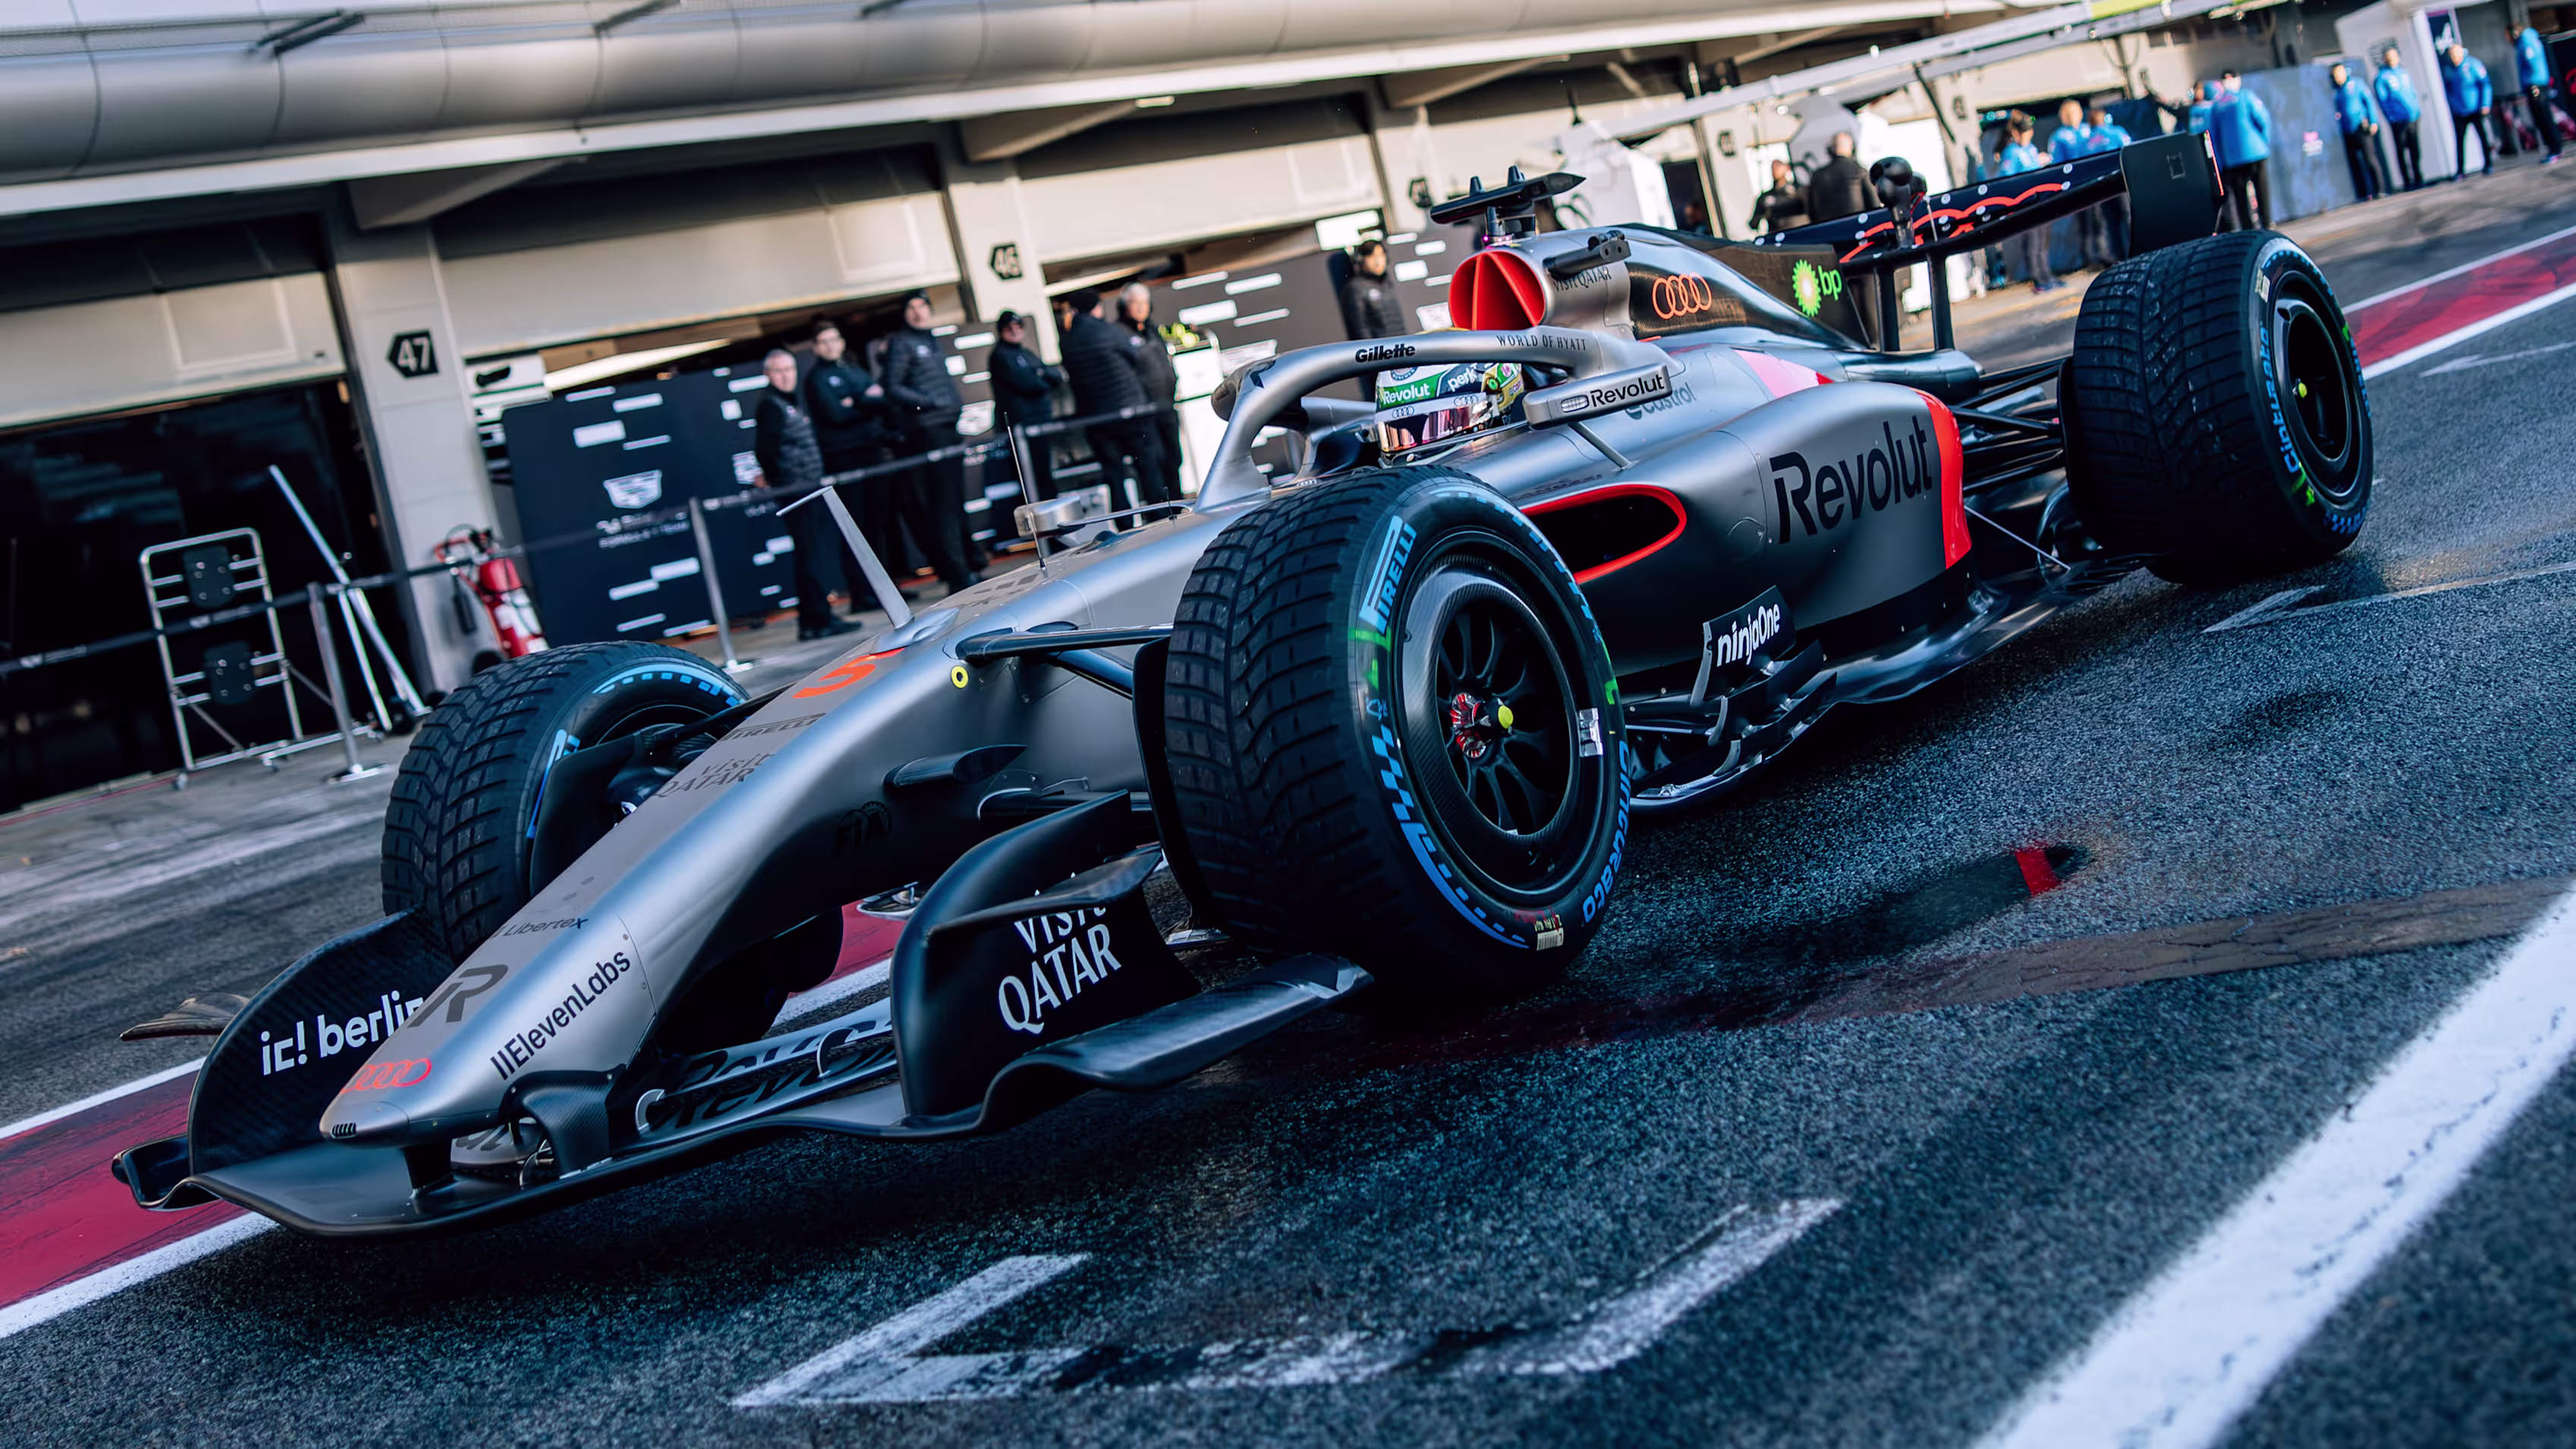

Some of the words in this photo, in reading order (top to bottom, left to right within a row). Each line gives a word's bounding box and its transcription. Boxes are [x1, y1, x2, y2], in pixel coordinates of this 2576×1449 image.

[1817, 265, 1842, 301] bp
[397, 336, 431, 372] 47
[1355, 343, 1416, 363] Gillette
[1496, 335, 1538, 347] WORLD
[1542, 336, 1553, 348] OF
[1557, 336, 1586, 352] HYATT
[1383, 383, 1431, 405] Revolut
[1590, 374, 1665, 407] Revolut
[1769, 415, 1933, 545] Revolut
[1359, 515, 1417, 635] PIRELLI
[1717, 604, 1780, 667] ninjaOne
[791, 647, 906, 699] 5
[503, 917, 589, 937] Libertex
[999, 923, 1122, 1034] QATAR
